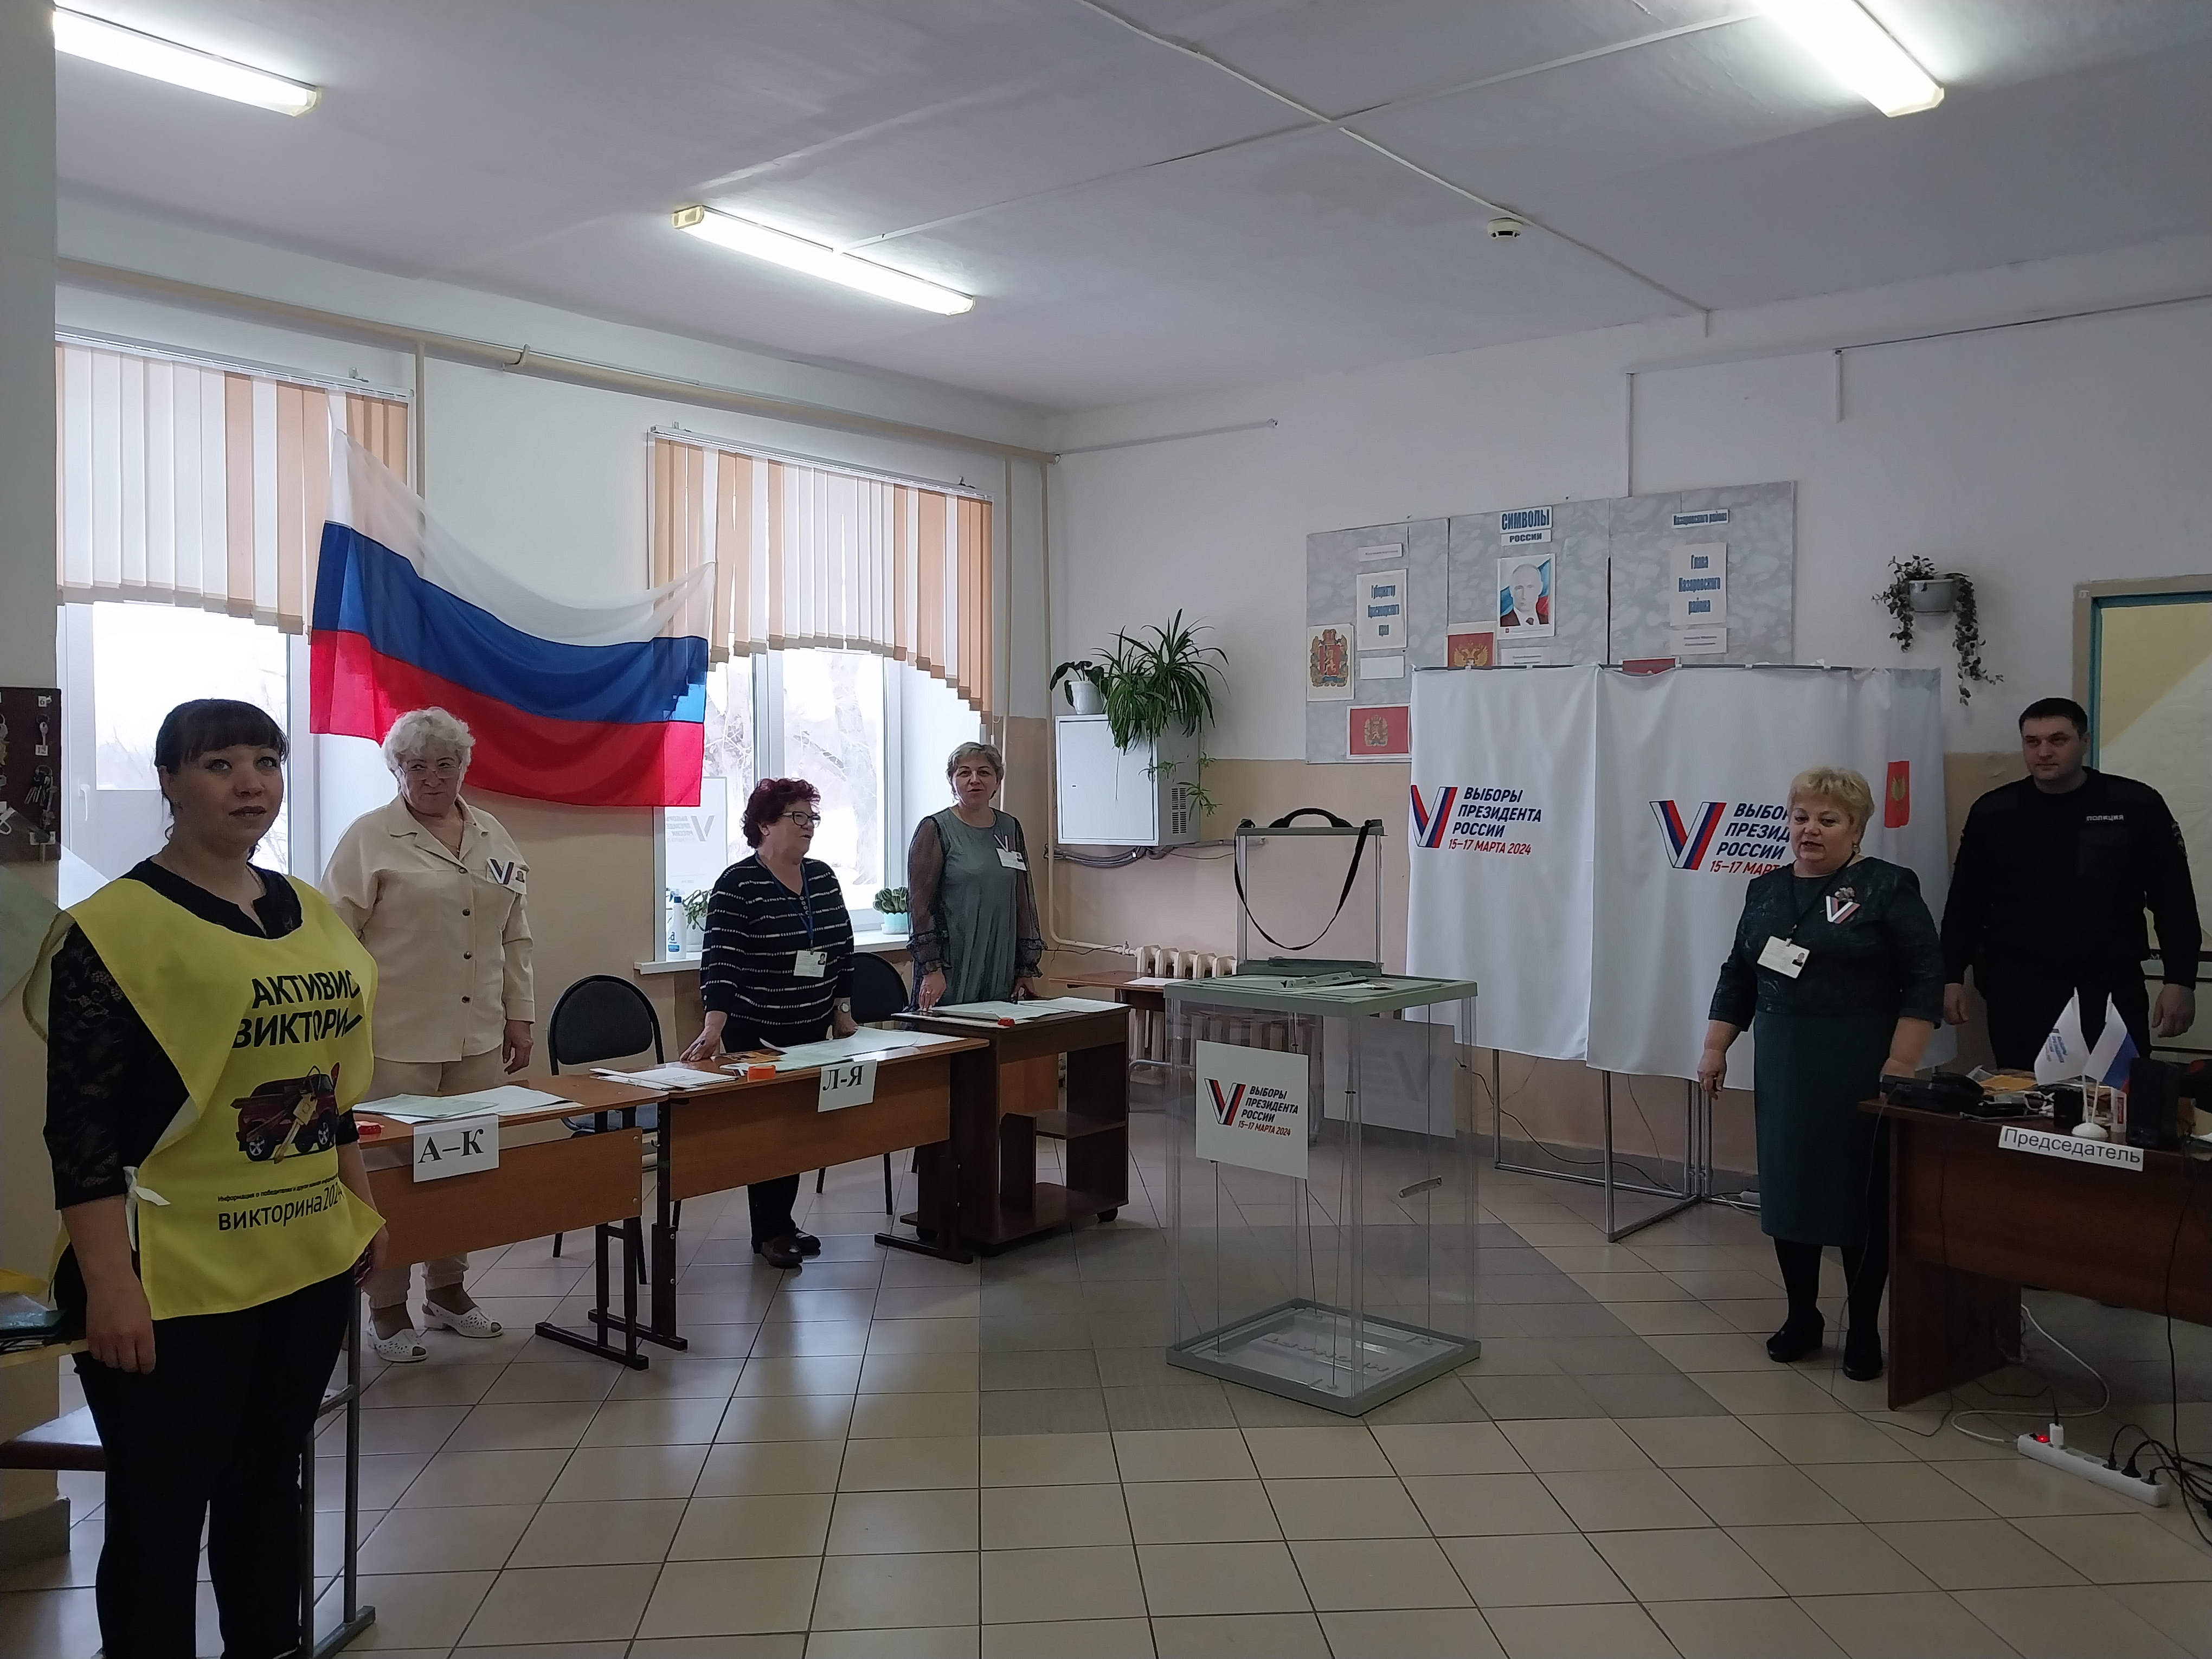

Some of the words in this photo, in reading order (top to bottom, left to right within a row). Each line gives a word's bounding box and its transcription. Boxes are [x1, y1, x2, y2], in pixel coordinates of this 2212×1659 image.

[1502, 509, 1549, 530] СИМВОЛЫ
[1509, 532, 1542, 543] РОССИИ
[1463, 787, 1523, 803] ВЫБОРЫ
[1457, 804, 1542, 822] ПРЕЗИДЕНТА
[1452, 822, 1506, 838] РОССИИ
[1448, 839, 1474, 850] 15–17
[1474, 840, 1506, 854] МАРТА
[1507, 843, 1532, 855] 2024
[1716, 842, 1786, 860] РОССИИ
[1710, 860, 1743, 874] 15–17
[252, 969, 360, 1009] АКТИВИС
[823, 1065, 864, 1090] Л-Я
[1249, 1086, 1288, 1099] ВЫБОРЫ
[1245, 1097, 1298, 1114] ПРЕЗИДЕНТА
[1241, 1109, 1275, 1122] РОССИИ
[1255, 1123, 1275, 1134] МАРТА
[1276, 1127, 1291, 1136] 2024
[2004, 1128, 2140, 1163] Председатель
